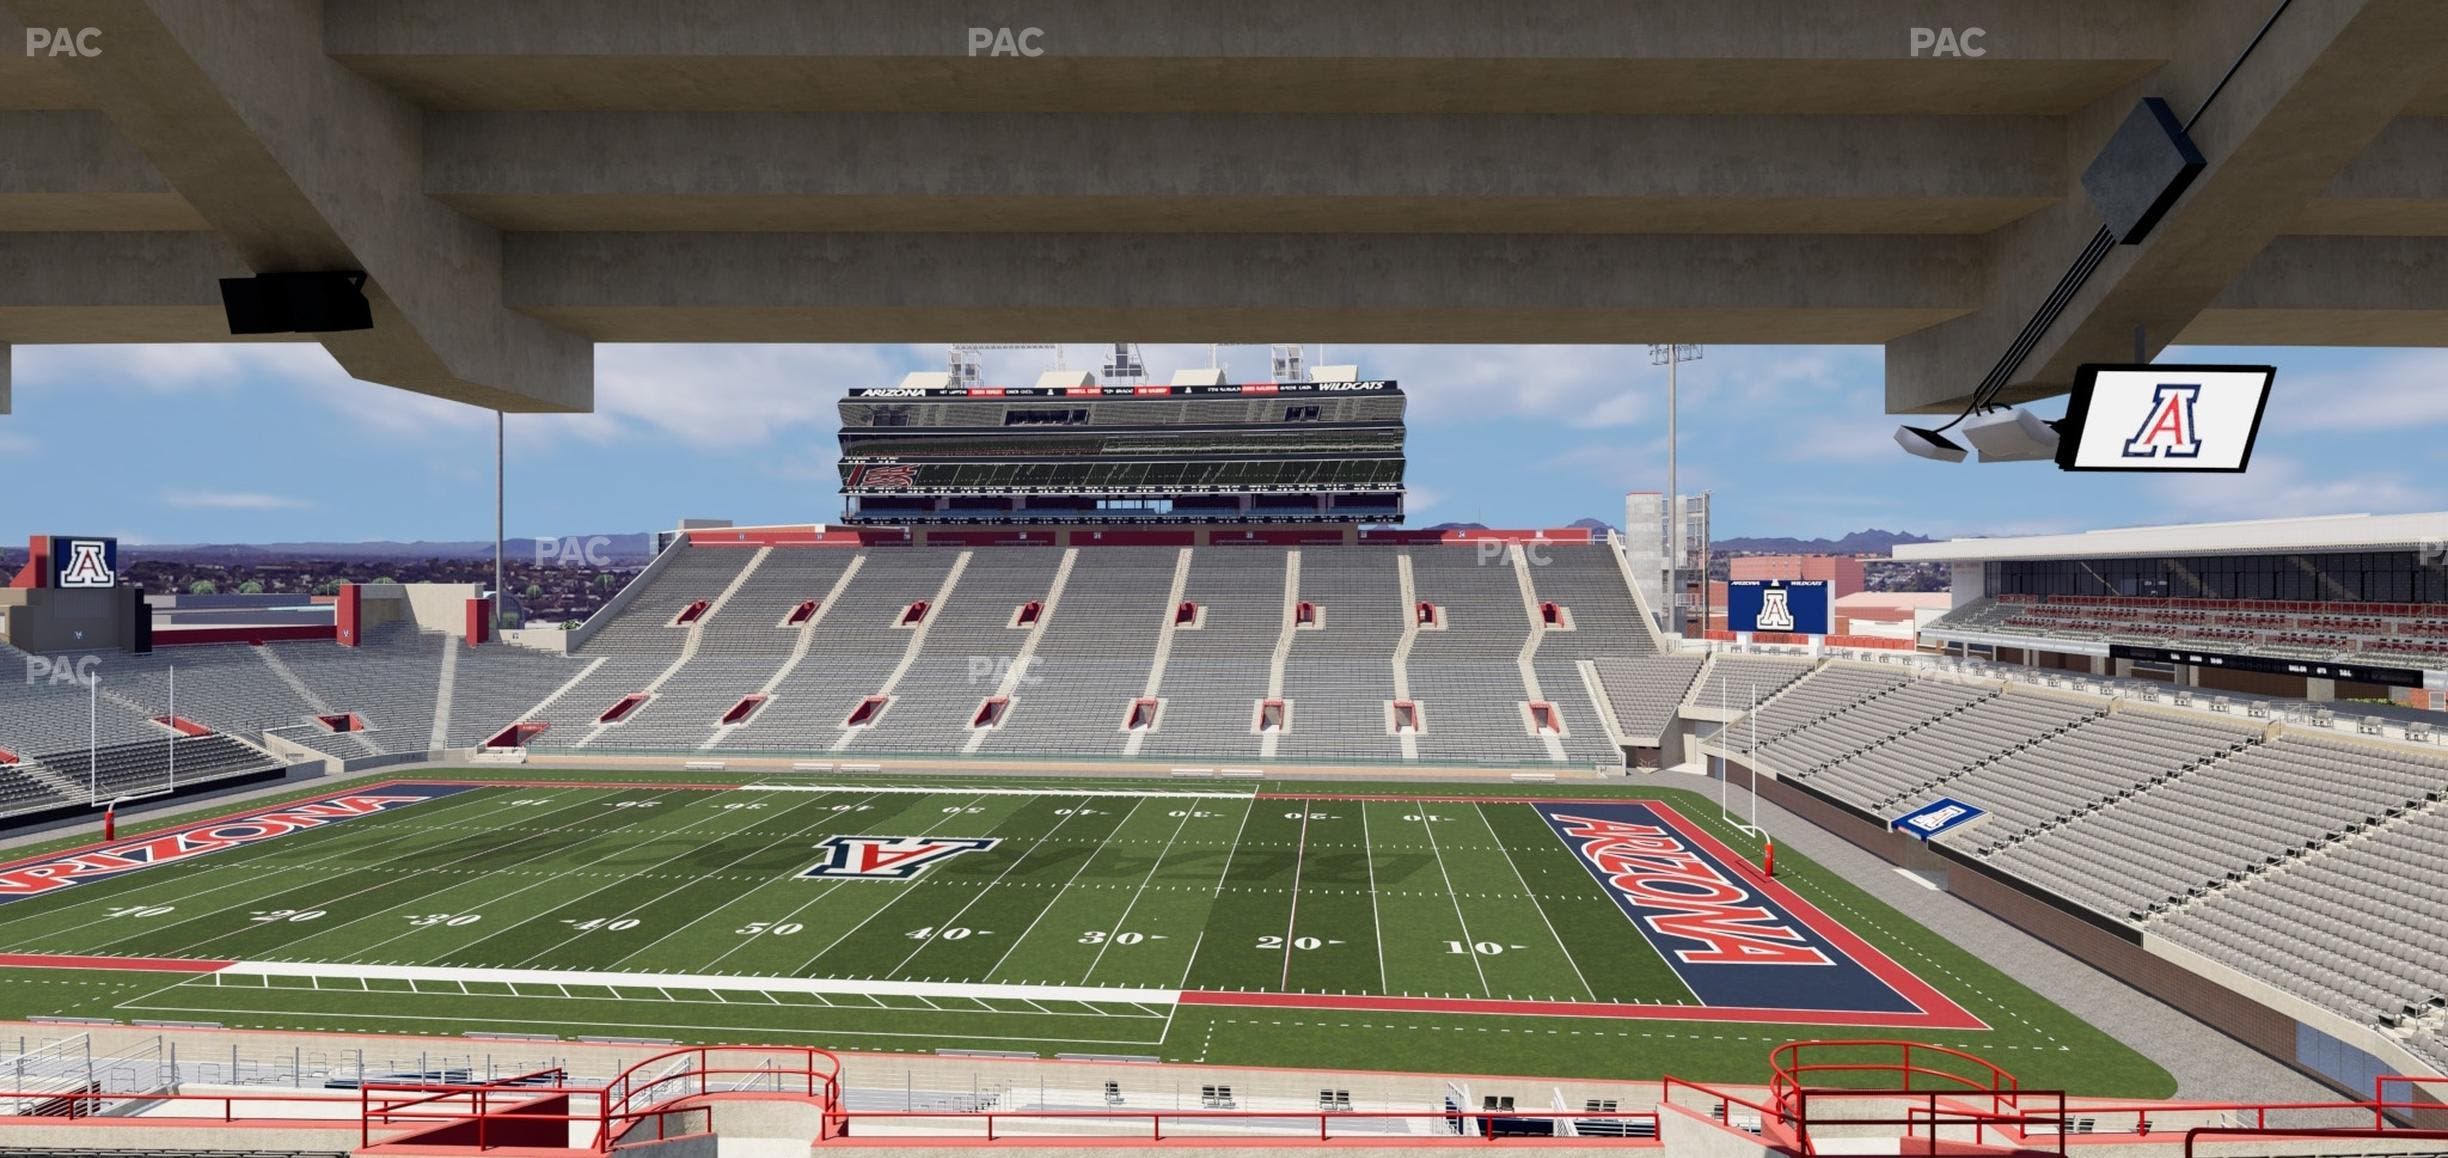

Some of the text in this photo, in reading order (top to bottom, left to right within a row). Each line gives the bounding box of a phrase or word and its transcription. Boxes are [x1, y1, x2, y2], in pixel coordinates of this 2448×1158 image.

[860, 389, 926, 397] ARIZONA
[1319, 381, 1384, 391] WILDCATS
[2122, 384, 2203, 459] A
[61, 541, 114, 588] A
[1756, 589, 1794, 630] A
[1550, 813, 1837, 966] ARIZONA
[250, 910, 327, 921] 20
[410, 914, 482, 926] 30
[570, 918, 641, 931] 40
[735, 922, 804, 935] 50
[905, 926, 972, 940] 40
[1077, 931, 1144, 945] 30
[1256, 935, 1322, 950] 20
[1442, 940, 1503, 955] 10
